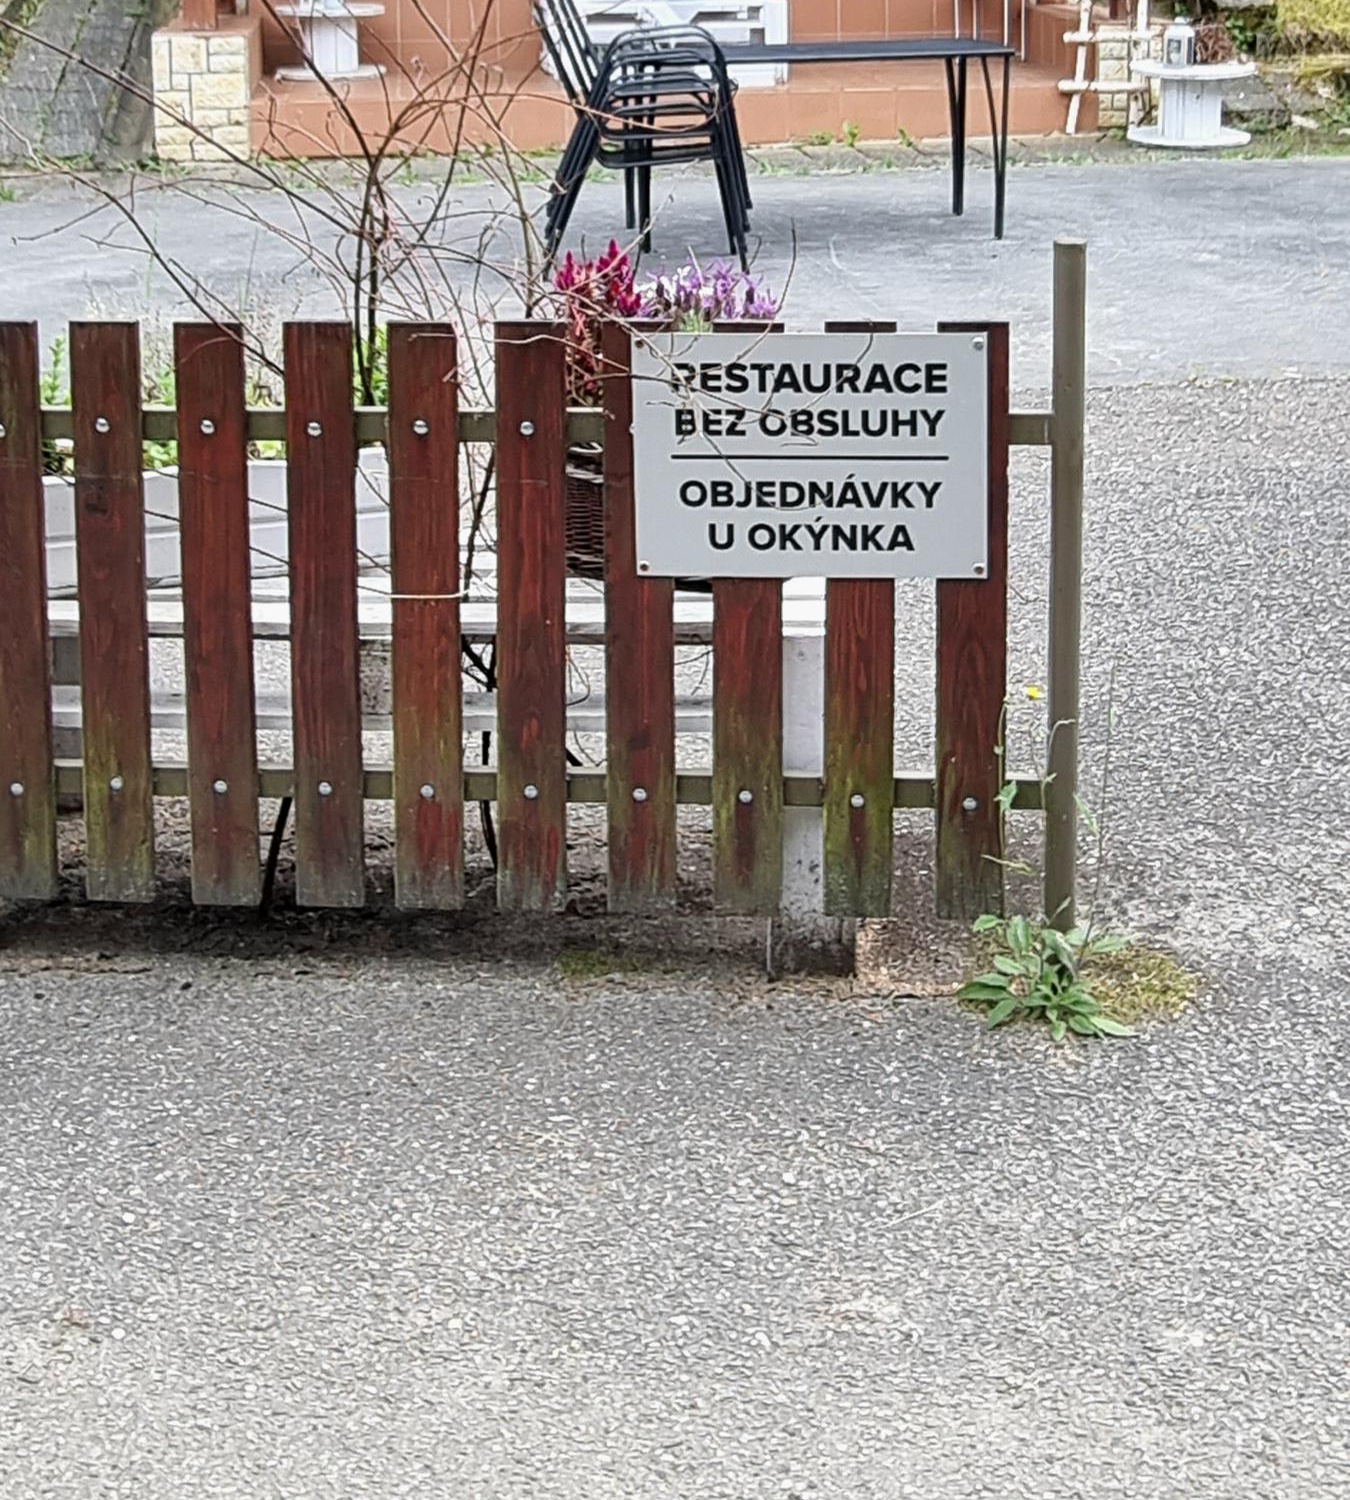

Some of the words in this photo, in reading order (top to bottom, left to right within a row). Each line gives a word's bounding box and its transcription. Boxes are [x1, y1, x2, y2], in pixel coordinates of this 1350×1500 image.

[671, 363, 948, 393] RESTAURACE
[675, 409, 747, 436] BEZ
[759, 409, 945, 437] OBSLUHY
[679, 474, 942, 509] OBJEDNÁVKY
[709, 523, 735, 550] U
[747, 516, 915, 551] OKÝNKA
